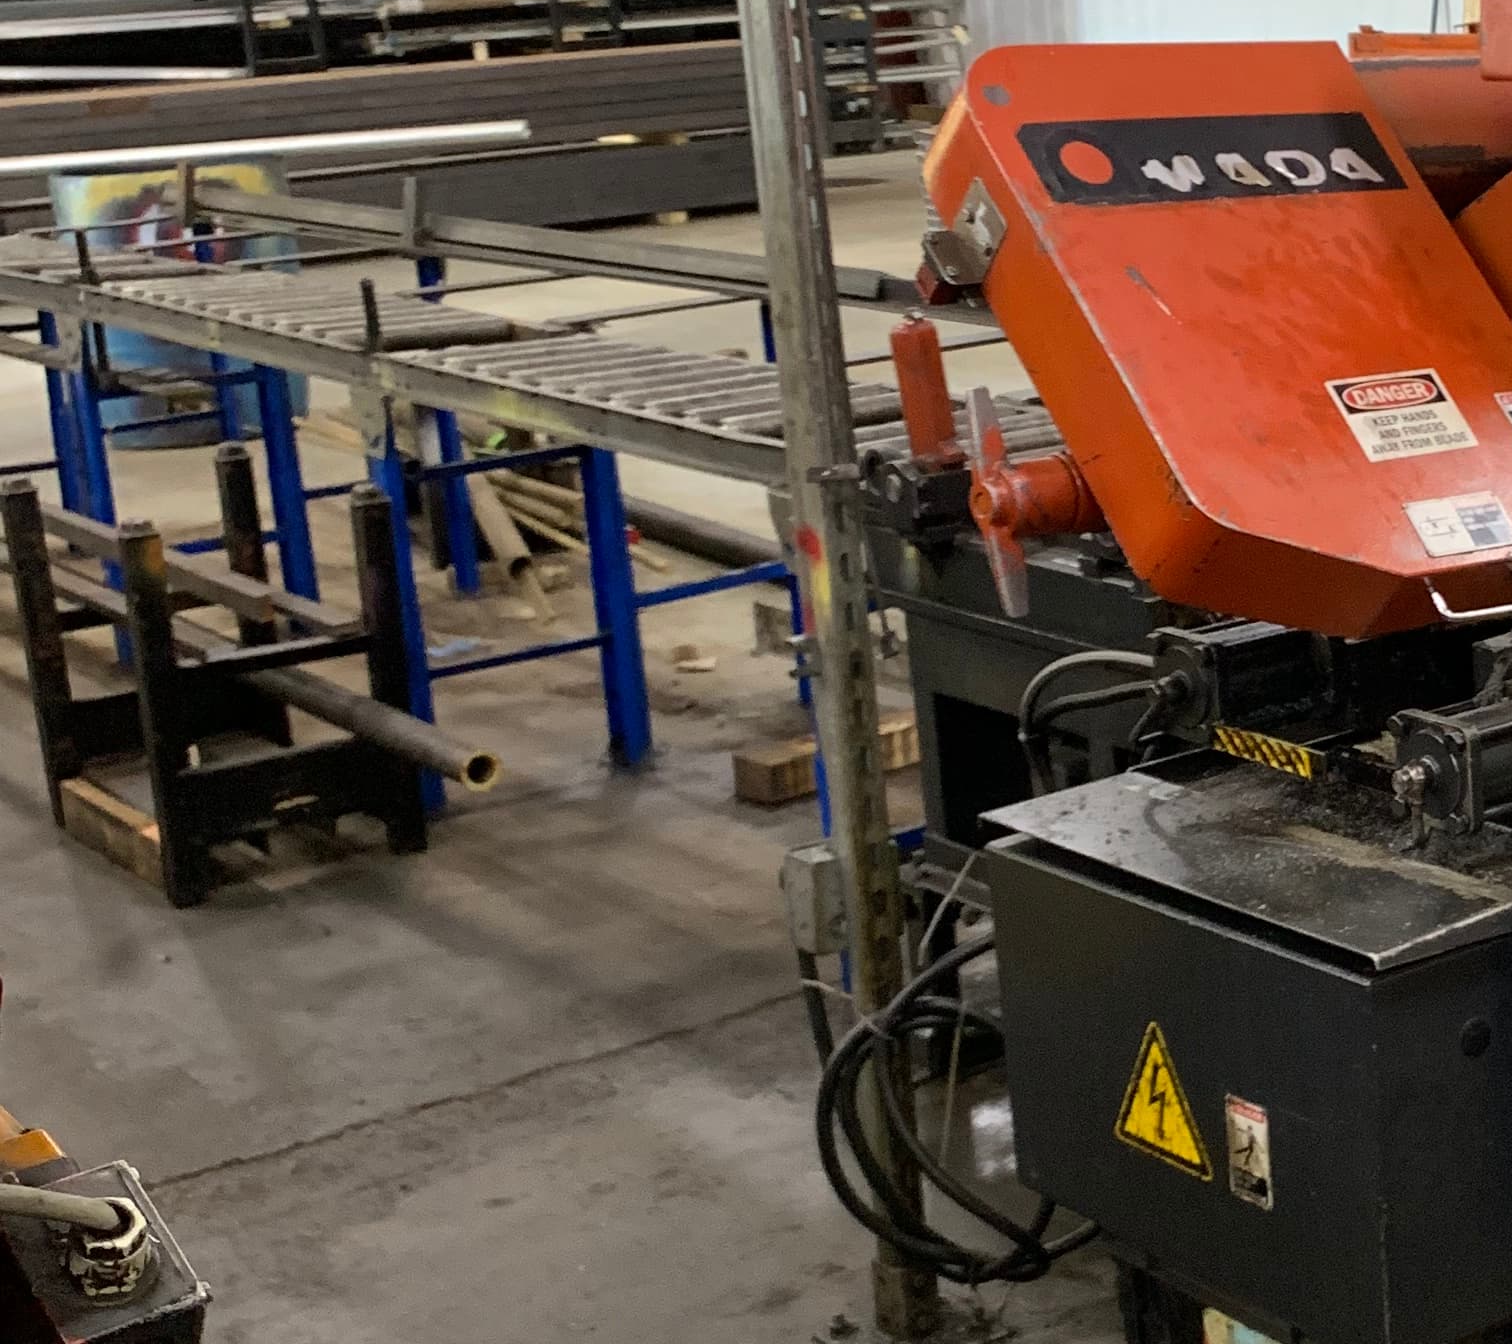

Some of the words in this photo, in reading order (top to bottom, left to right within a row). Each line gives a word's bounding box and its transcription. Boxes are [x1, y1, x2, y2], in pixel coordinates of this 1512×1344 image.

[1351, 382, 1430, 406] DANGER
[1372, 414, 1399, 427] KEEP
[1402, 409, 1438, 423] HANDS
